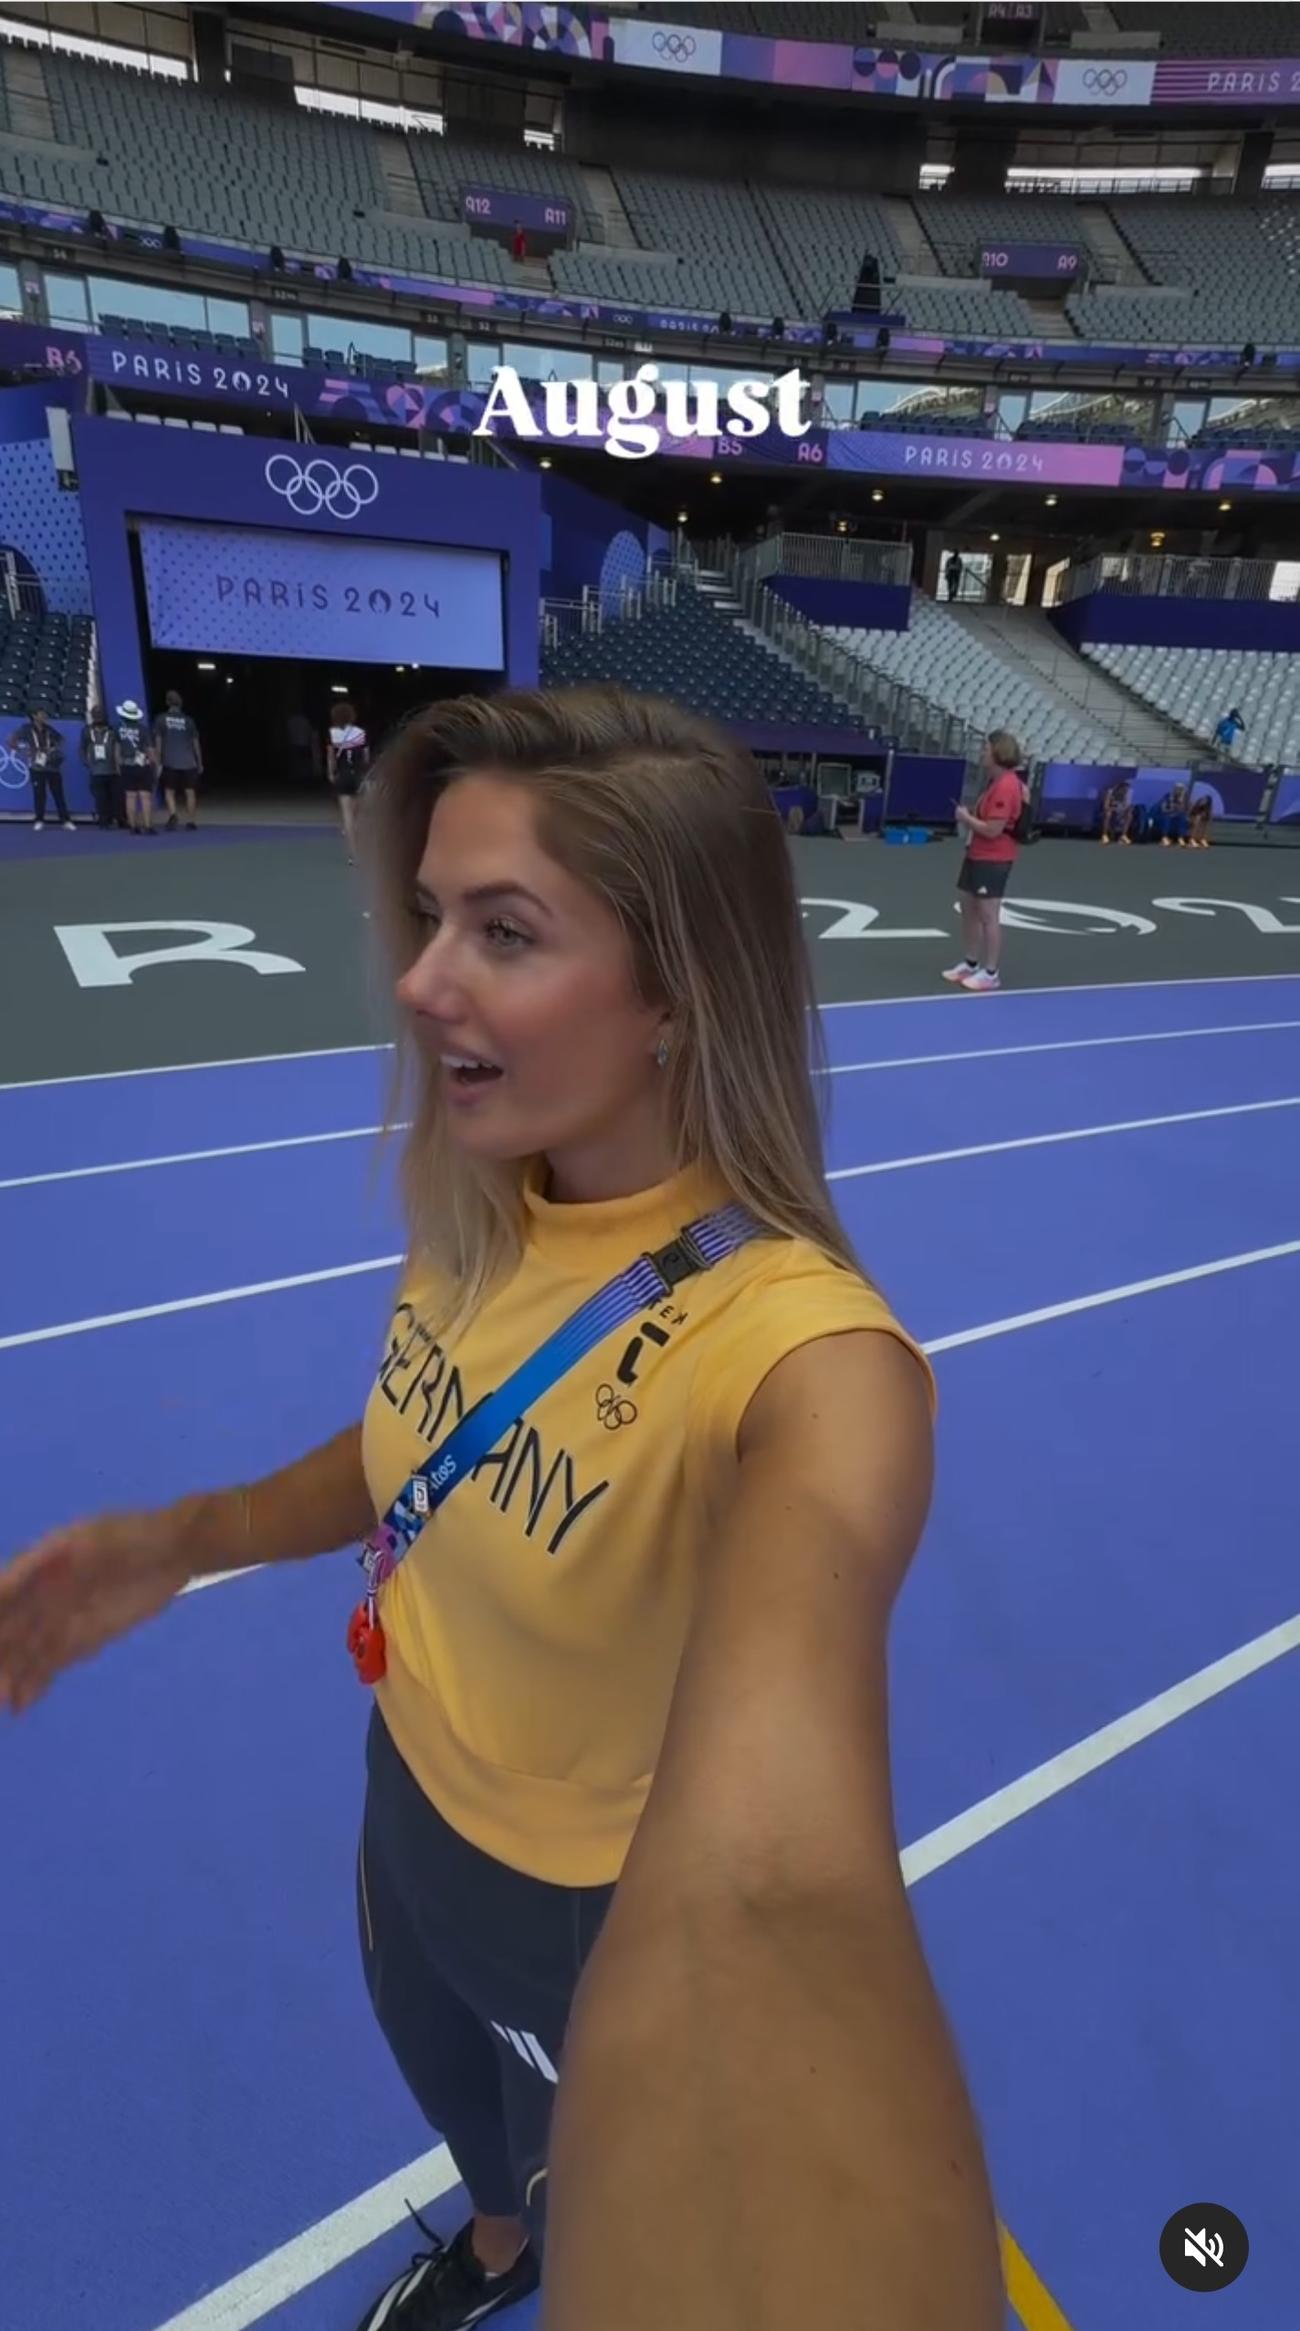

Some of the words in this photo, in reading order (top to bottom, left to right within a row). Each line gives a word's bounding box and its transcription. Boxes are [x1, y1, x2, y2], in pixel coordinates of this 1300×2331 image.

[1207, 71, 1281, 92] PARIS
[544, 207, 567, 225] A11
[1057, 255, 1078, 271] A9
[213, 367, 290, 399] 2024
[718, 436, 743, 455] B5
[798, 442, 823, 463] A6
[905, 445, 973, 469] PARIS
[982, 451, 1044, 472] 2024
[344, 587, 440, 619] 2024
